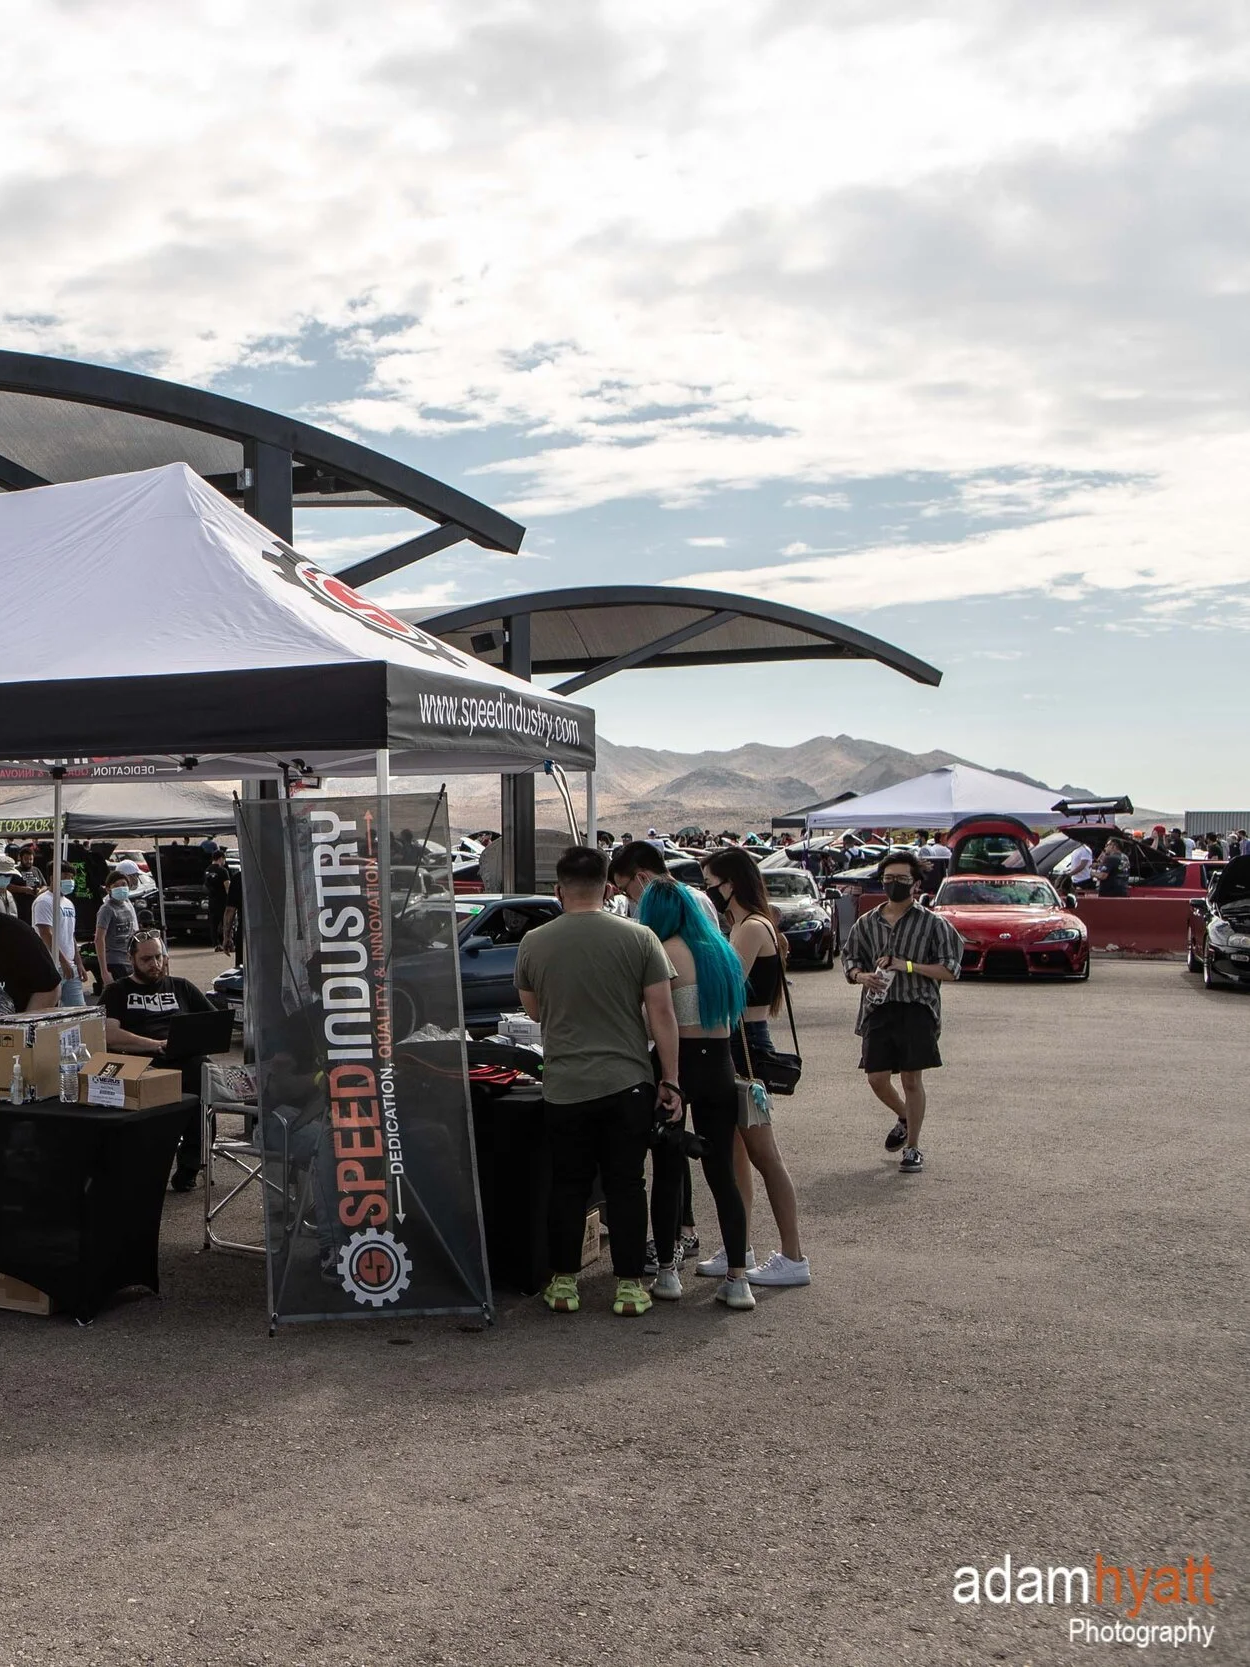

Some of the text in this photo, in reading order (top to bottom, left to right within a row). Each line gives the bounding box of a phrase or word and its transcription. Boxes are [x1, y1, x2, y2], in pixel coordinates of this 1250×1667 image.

[418, 693, 580, 748] www.speedindustry.com
[128, 993, 177, 1009] HKS
[365, 856, 404, 1175] DEDICATION, QUALITY & INNOVATION
